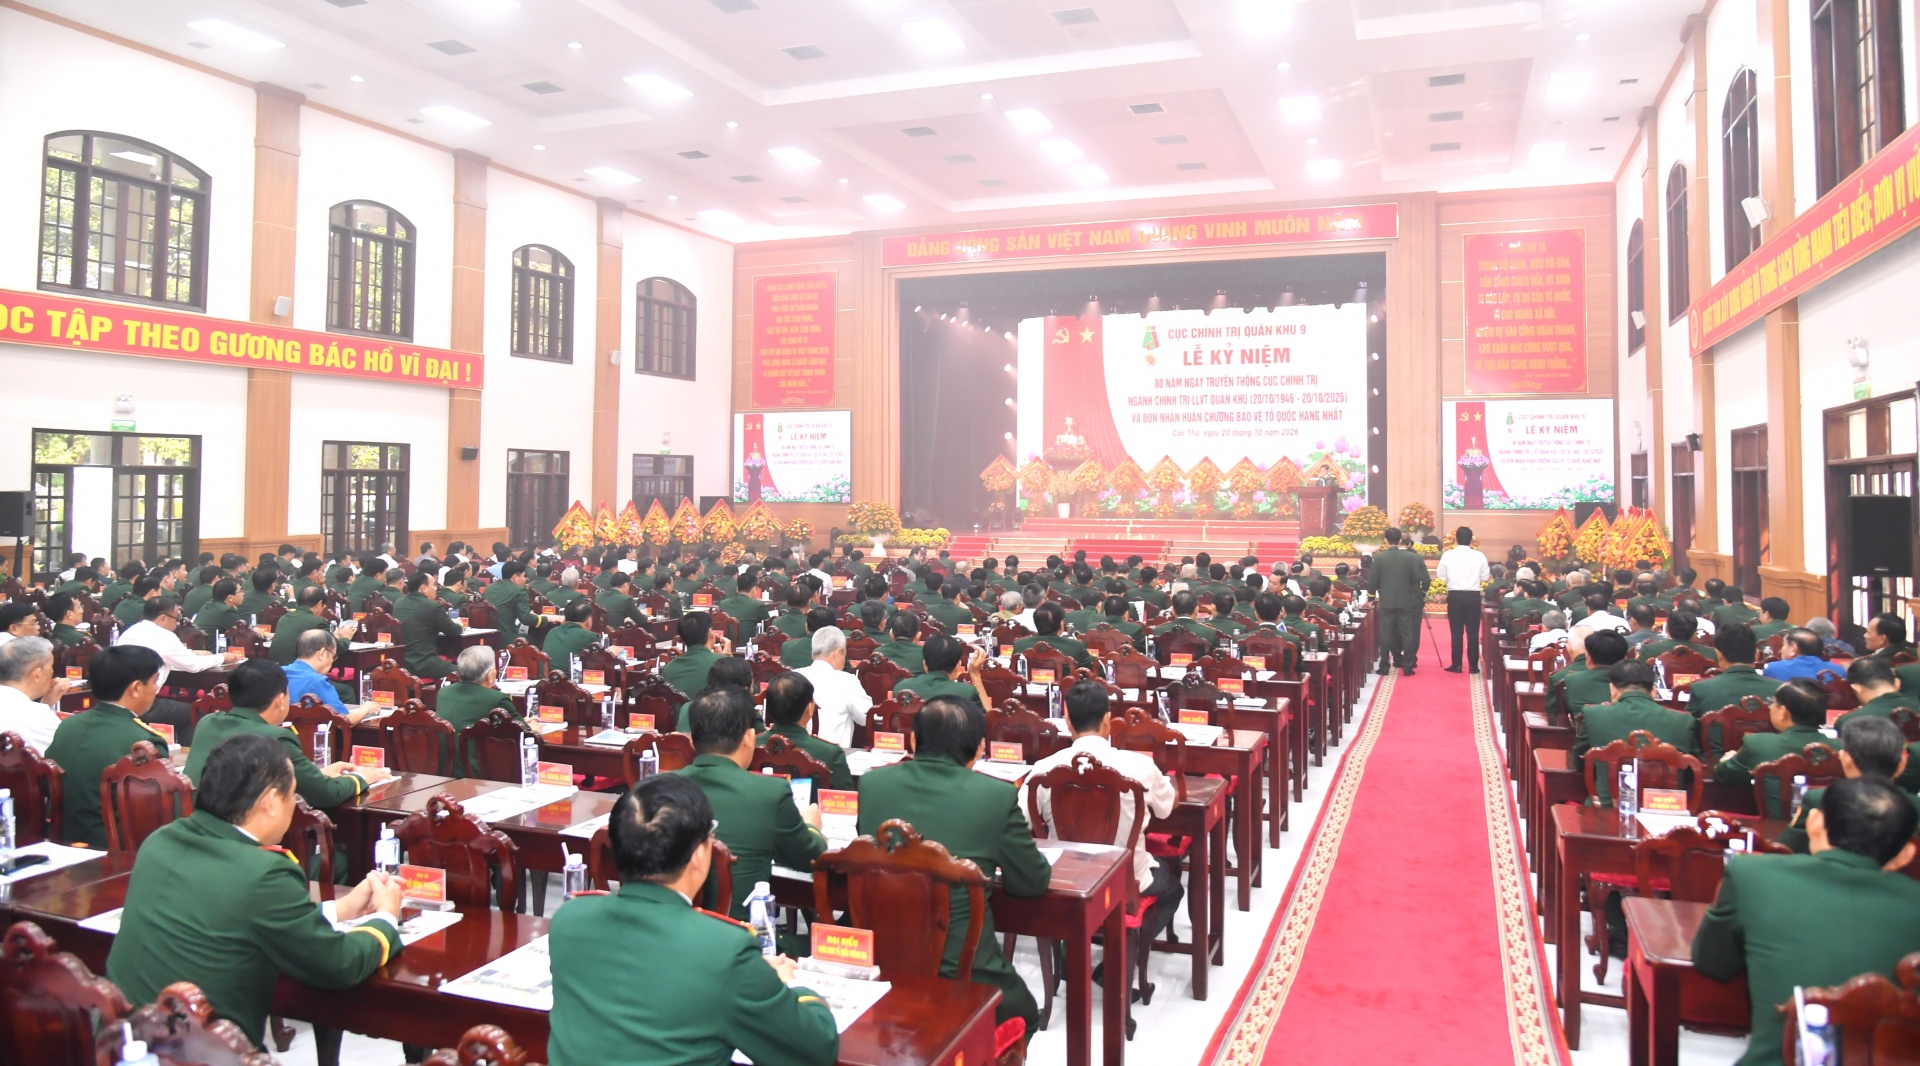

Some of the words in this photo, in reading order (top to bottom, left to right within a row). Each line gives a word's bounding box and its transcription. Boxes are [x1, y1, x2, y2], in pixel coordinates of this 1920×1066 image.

[1832, 202, 1850, 251] TIÊU
[1874, 174, 1894, 225] ĐƠN
[1894, 165, 1906, 218] VỊ
[907, 237, 951, 257] ĐẢNG
[1006, 230, 1040, 250] SẢN
[1046, 229, 1082, 251] VIỆT
[1090, 228, 1130, 246] NAM
[1138, 224, 1198, 244] QUANG
[1204, 221, 1247, 238] VINH
[1254, 215, 1310, 236] MUÔN
[1168, 328, 1188, 341] CỤC
[1191, 326, 1222, 338] CHÍNH
[1226, 326, 1240, 340] TRỊ
[1244, 323, 1272, 337] QUÂN
[1276, 324, 1297, 336] KHU
[1300, 324, 1307, 334] 9
[46, 308, 113, 347] TẬP
[123, 320, 200, 352] THEO
[210, 330, 302, 364] GƯƠNG
[309, 338, 357, 370] BÁC
[364, 345, 394, 374] HỒ
[400, 351, 420, 376] VĨ
[425, 360, 460, 386] ĐẠI
[465, 363, 472, 382] !
[1182, 344, 1204, 366] LỄ
[1210, 342, 1234, 366] KỶ
[1240, 344, 1291, 368] NIỆM
[1262, 376, 1278, 389] CỤC
[1280, 374, 1304, 386] CHÍNH
[1306, 374, 1318, 388] TRỊ
[1154, 394, 1178, 406] CHÍNH
[1179, 394, 1190, 407] TRỊ
[1192, 394, 1208, 406] LLVT
[1233, 394, 1248, 405] KHU
[1298, 410, 1320, 424] HẠNG
[1221, 428, 1231, 436] 20
[1254, 428, 1263, 436] 10
[1281, 428, 1299, 436] 2026
